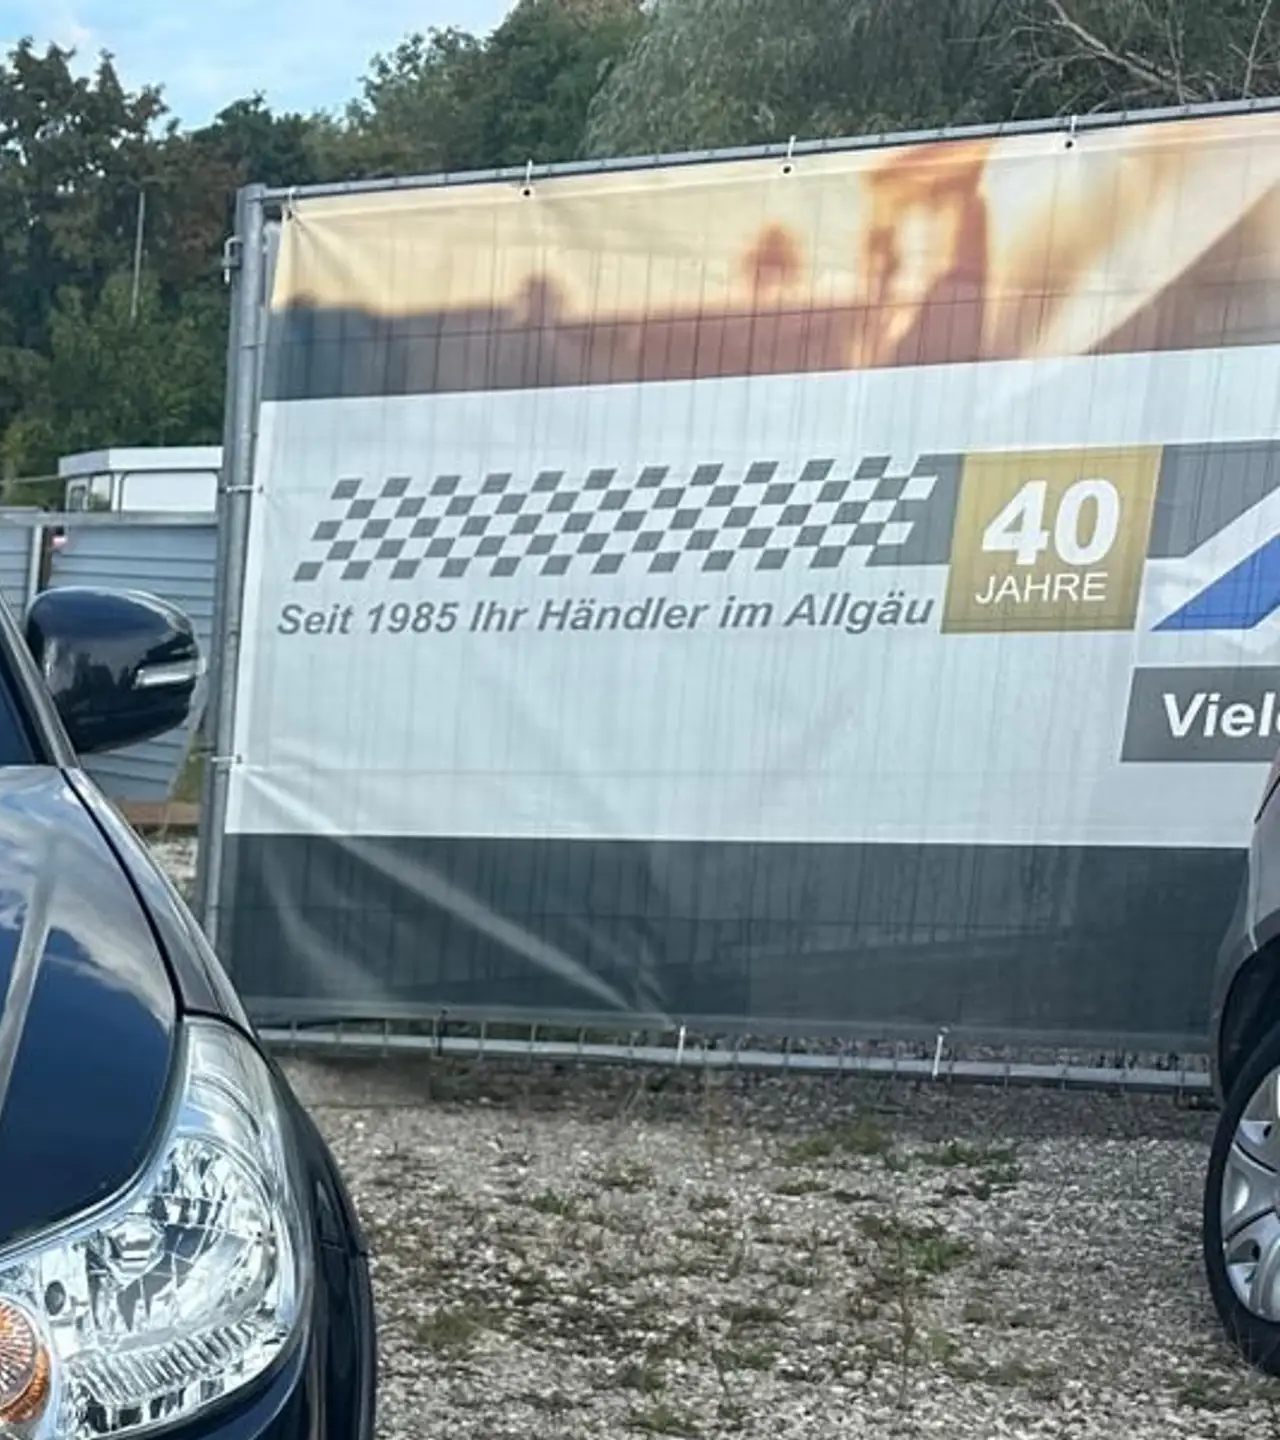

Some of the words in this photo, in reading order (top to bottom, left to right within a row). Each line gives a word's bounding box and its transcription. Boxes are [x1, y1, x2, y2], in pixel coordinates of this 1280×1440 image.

[982, 479, 1120, 566] 40
[975, 572, 1108, 604] JAHRE
[277, 603, 354, 634] Seit
[367, 601, 459, 634] 1985
[469, 600, 528, 632] Ihr
[538, 598, 709, 631] Händler
[719, 595, 773, 628] im
[782, 590, 935, 635] Allgäu
[1163, 692, 1280, 738] Viel
